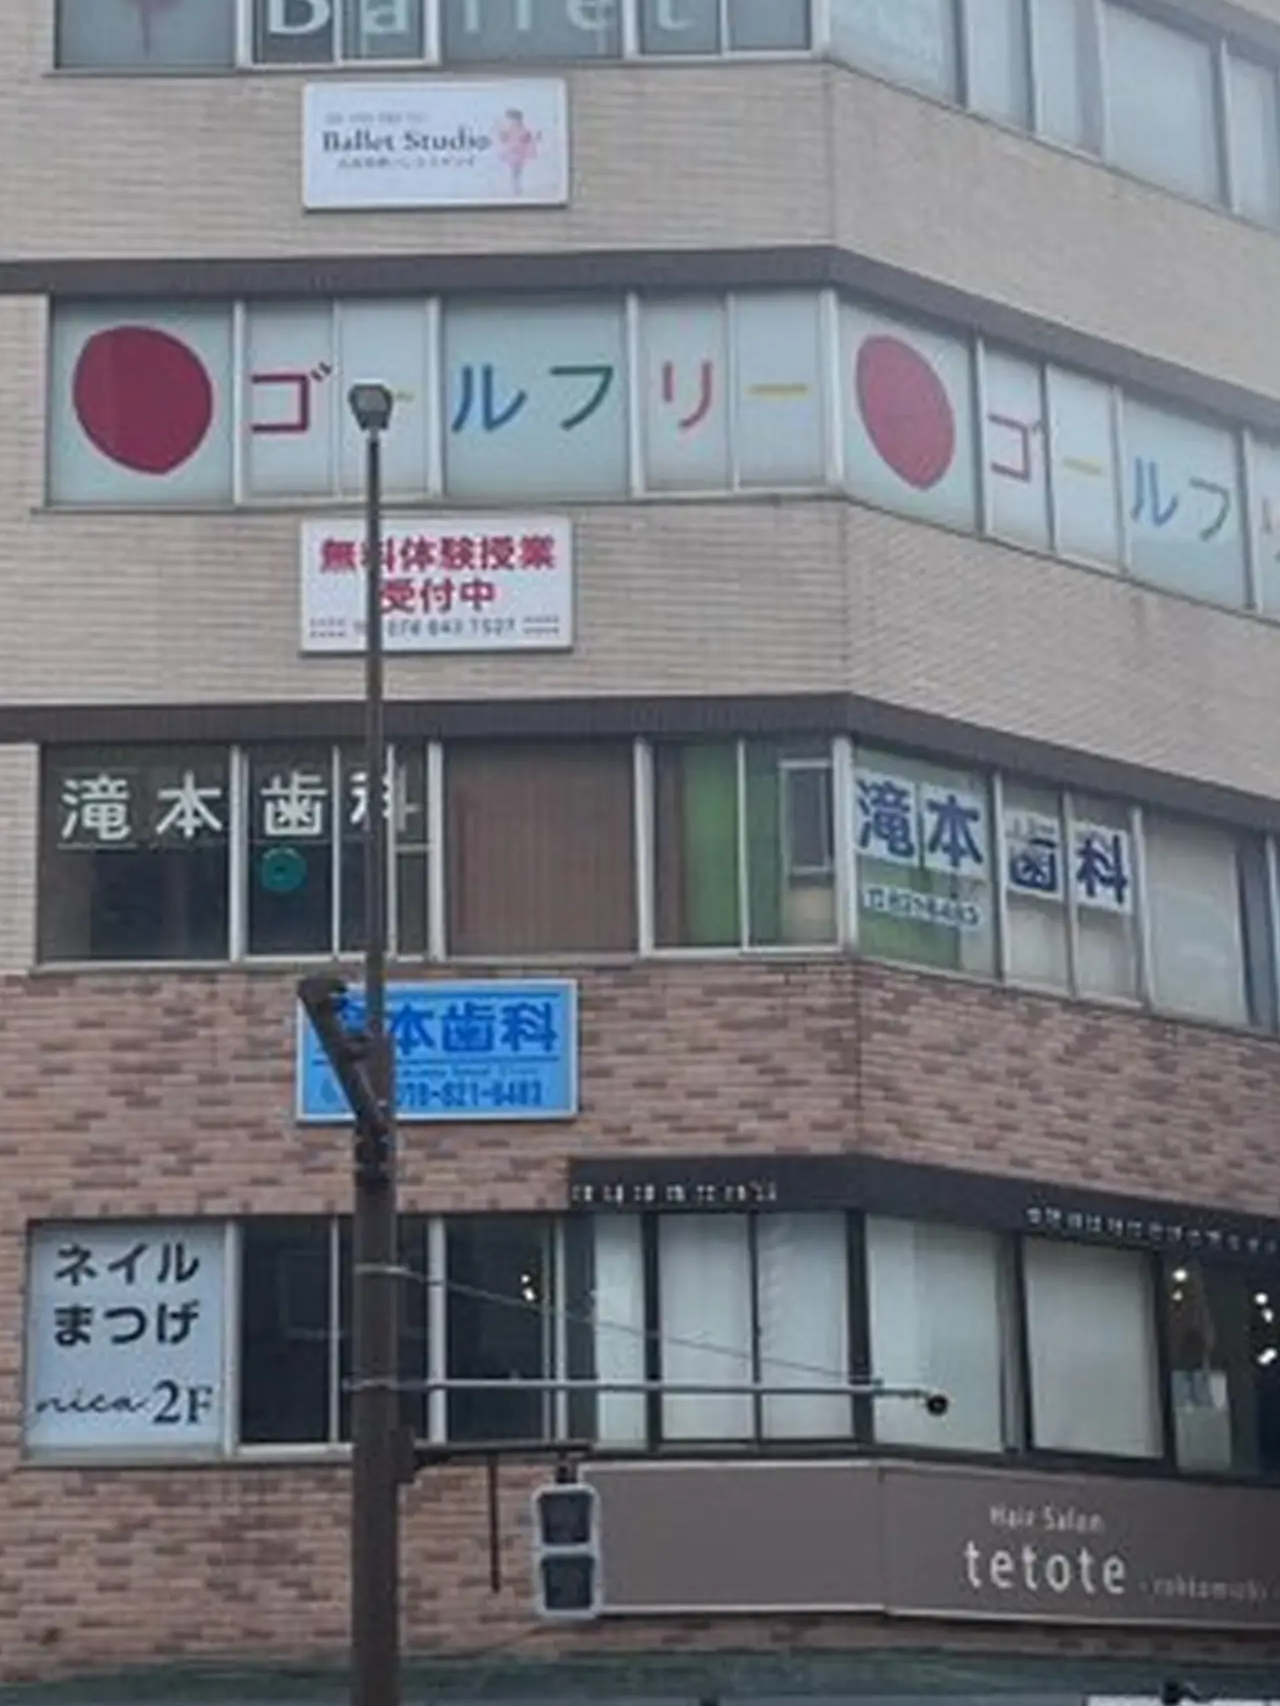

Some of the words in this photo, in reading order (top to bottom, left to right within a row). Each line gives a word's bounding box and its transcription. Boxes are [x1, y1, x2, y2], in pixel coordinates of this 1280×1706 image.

[321, 129, 396, 153] Ballet
[53, 1241, 200, 1288] ネイル
[53, 1303, 200, 1347] まつげ
[153, 1379, 214, 1425] 2F
[989, 1506, 1035, 1529] Hair
[963, 1541, 1126, 1595] tetote
